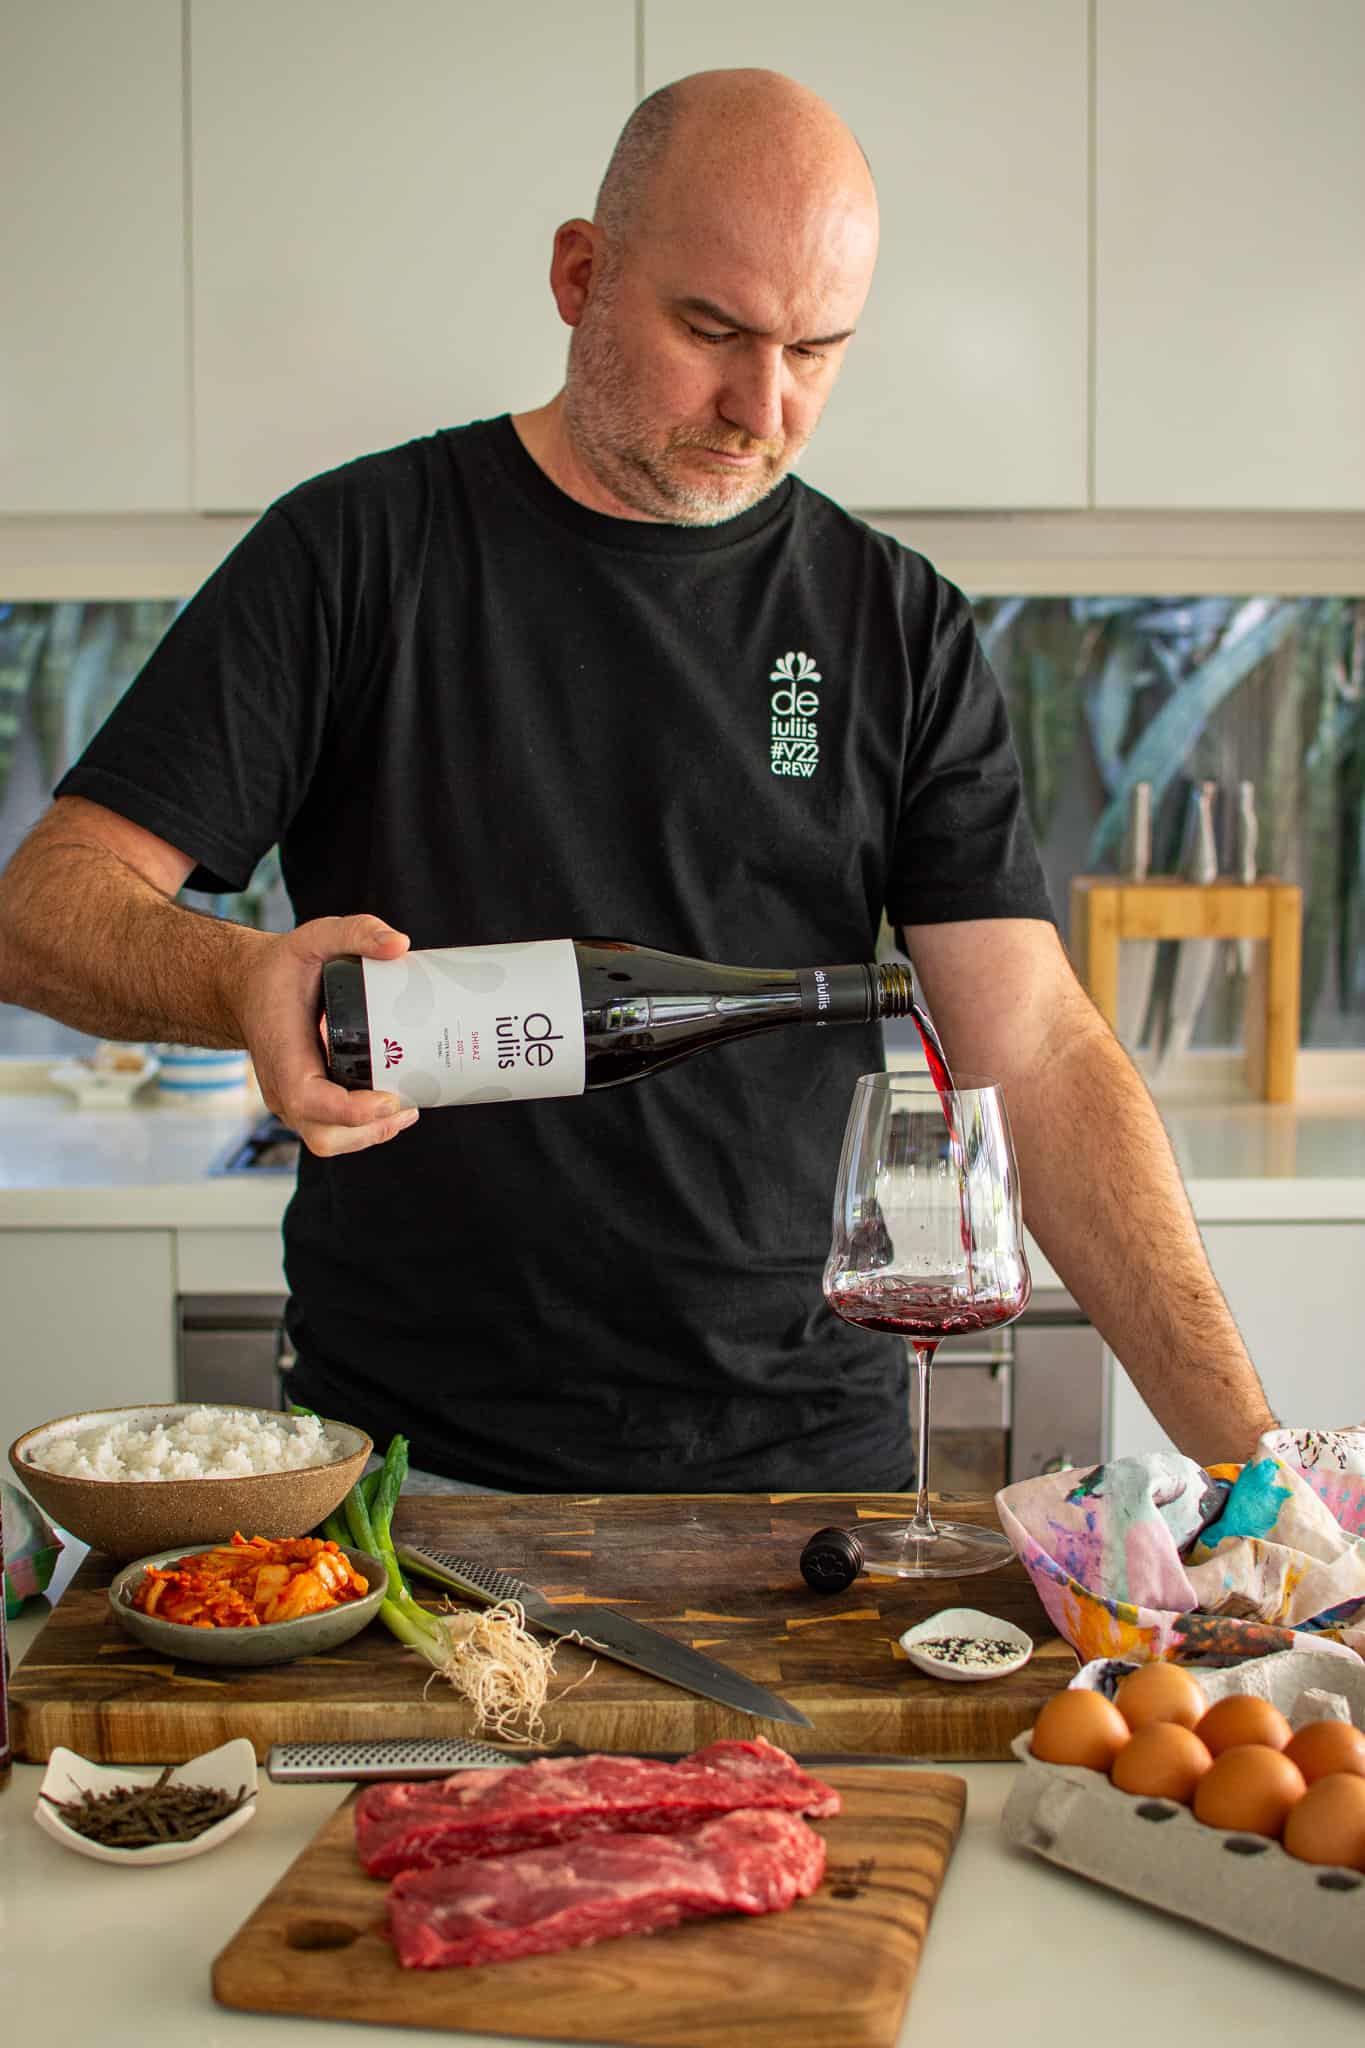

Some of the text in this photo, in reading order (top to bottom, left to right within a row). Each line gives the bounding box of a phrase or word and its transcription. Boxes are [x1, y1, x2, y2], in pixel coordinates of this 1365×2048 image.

[771, 682, 820, 717] de
[771, 717, 818, 738] iuliis
[770, 741, 820, 763] #V22
[771, 760, 817, 778] CREW
[471, 1031, 481, 1061] SHIRAZ
[495, 1015, 521, 1070] iuliis
[523, 1012, 564, 1067] de
